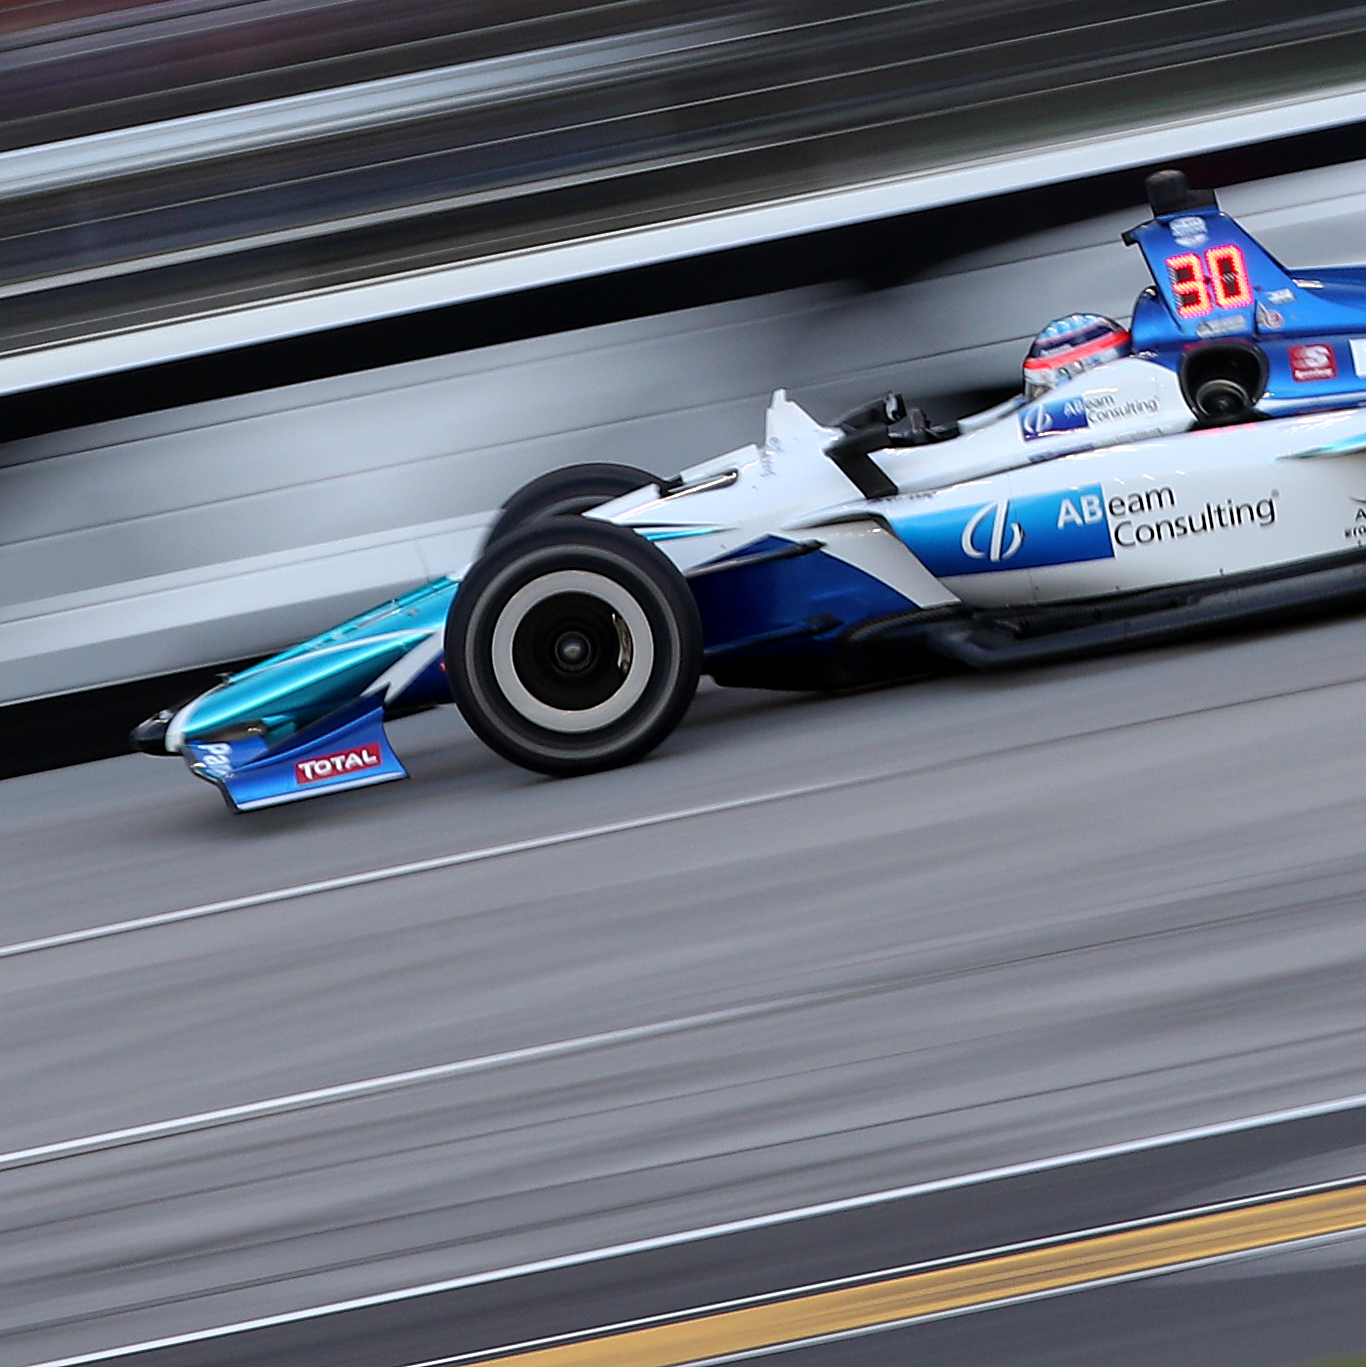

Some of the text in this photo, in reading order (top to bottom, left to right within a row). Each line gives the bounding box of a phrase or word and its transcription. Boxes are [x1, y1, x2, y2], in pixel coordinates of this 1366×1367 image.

[1165, 244, 1254, 319] 30
[1057, 485, 1177, 529] ABeam
[1113, 495, 1278, 548] Consulting
[297, 749, 378, 780] TOTAL
